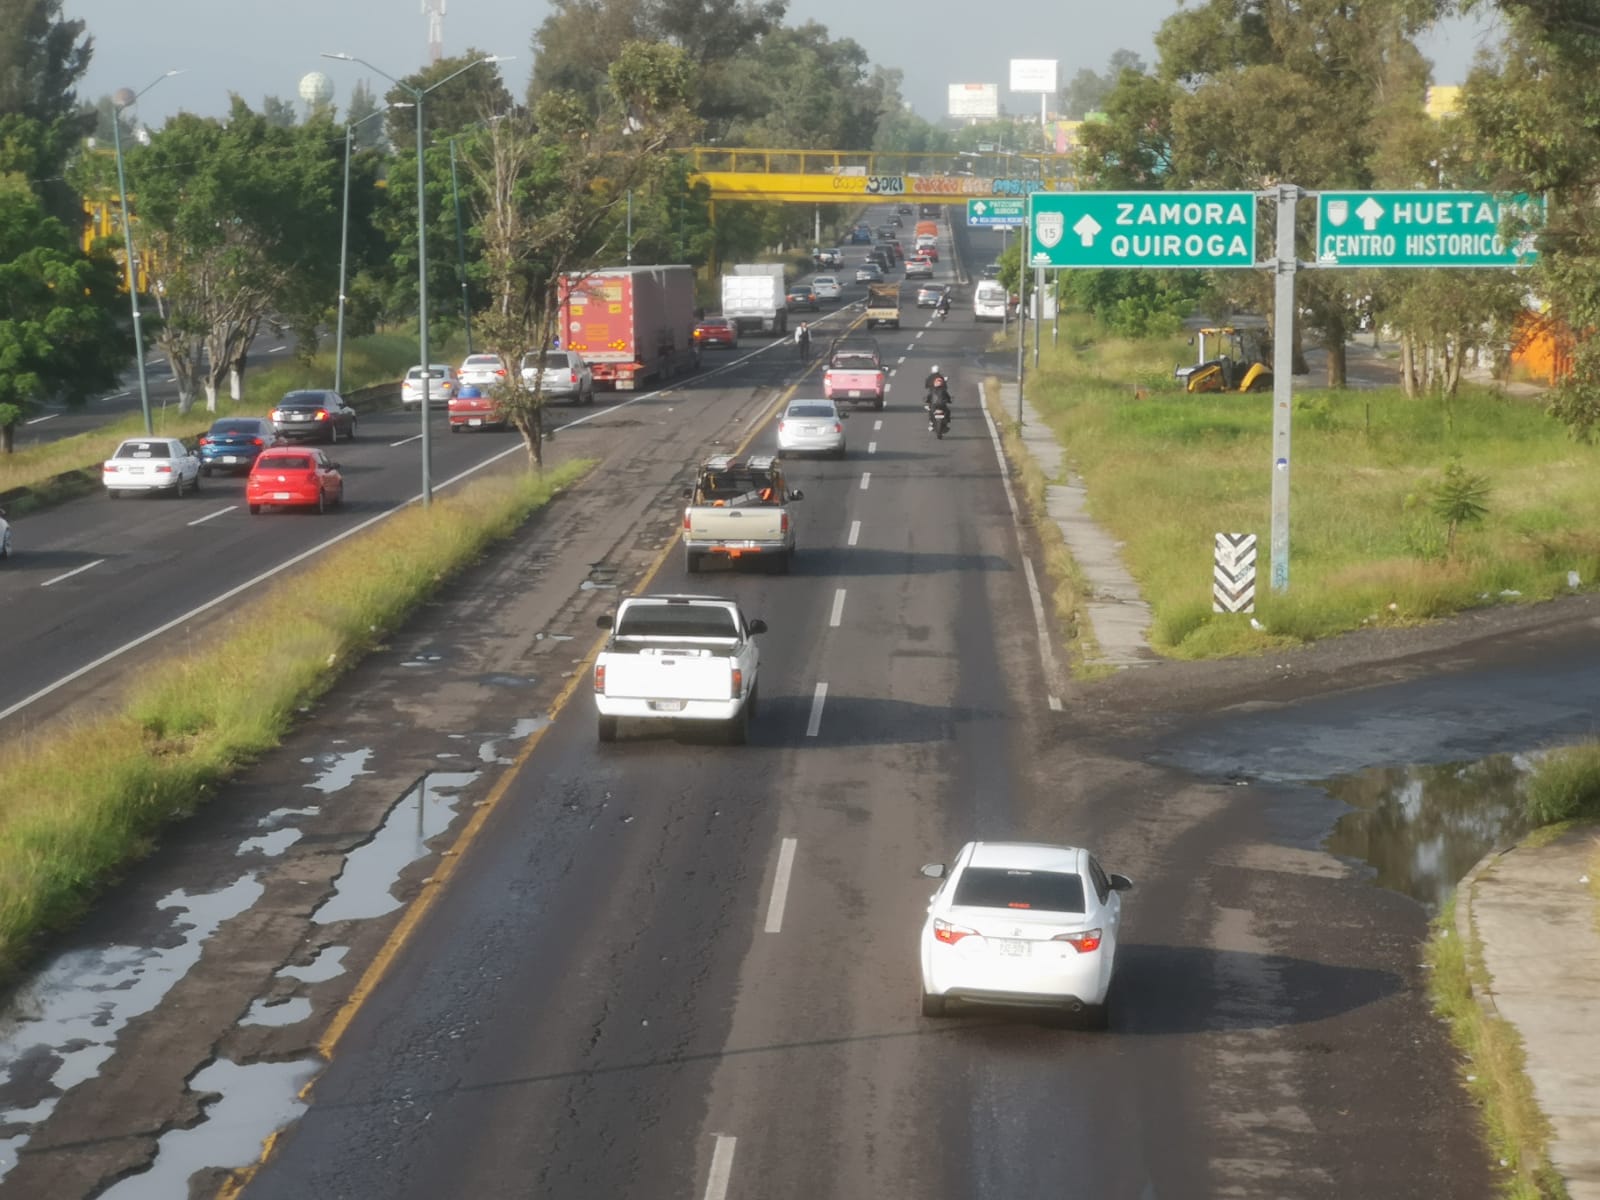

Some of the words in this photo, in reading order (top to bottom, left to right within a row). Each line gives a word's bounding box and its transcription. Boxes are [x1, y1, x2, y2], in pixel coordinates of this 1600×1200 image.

[1117, 203, 1247, 225] ZAMORA
[1044, 228, 1056, 239] 15
[1111, 235, 1247, 257] QUIROGA
[1324, 235, 1395, 256] CENTRO
[1406, 235, 1503, 256] HISTORICO
